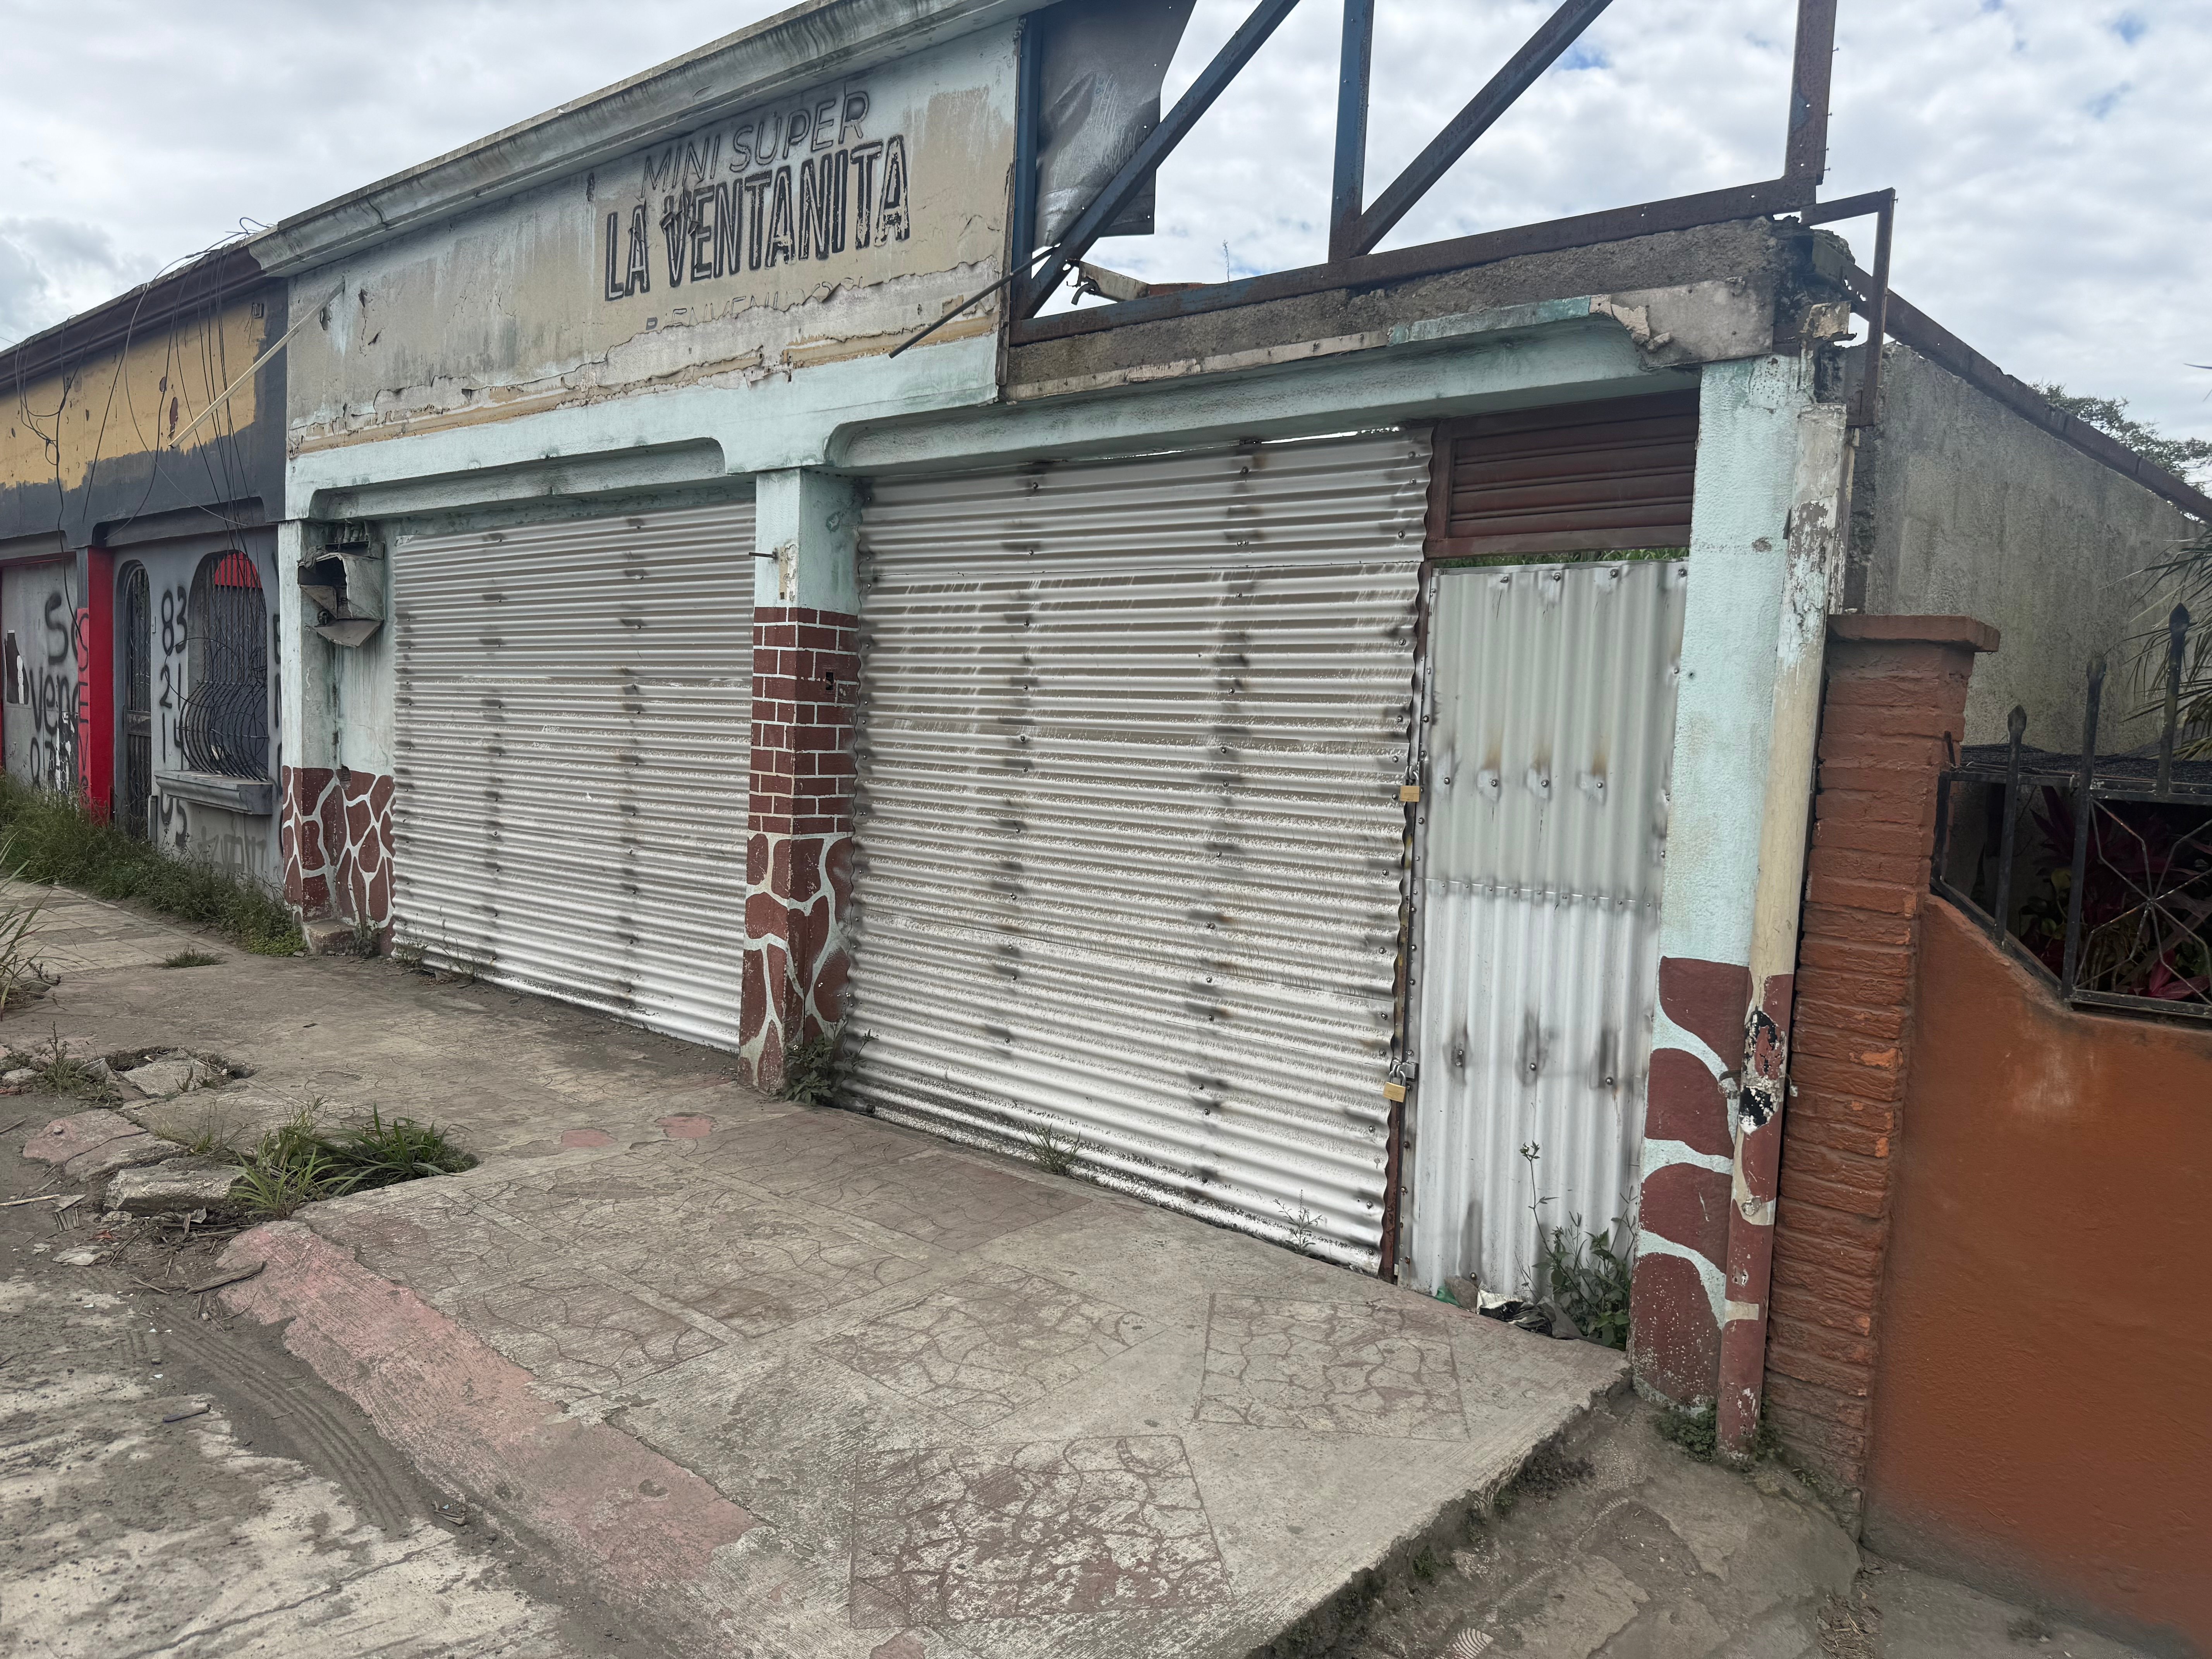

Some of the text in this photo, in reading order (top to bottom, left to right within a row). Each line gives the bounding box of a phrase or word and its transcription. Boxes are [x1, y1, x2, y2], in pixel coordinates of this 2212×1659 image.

[640, 82, 870, 198] MINI SUPER
[605, 134, 910, 302] LA VENTANITA
[161, 586, 188, 656] 83
[159, 663, 181, 712] 21
